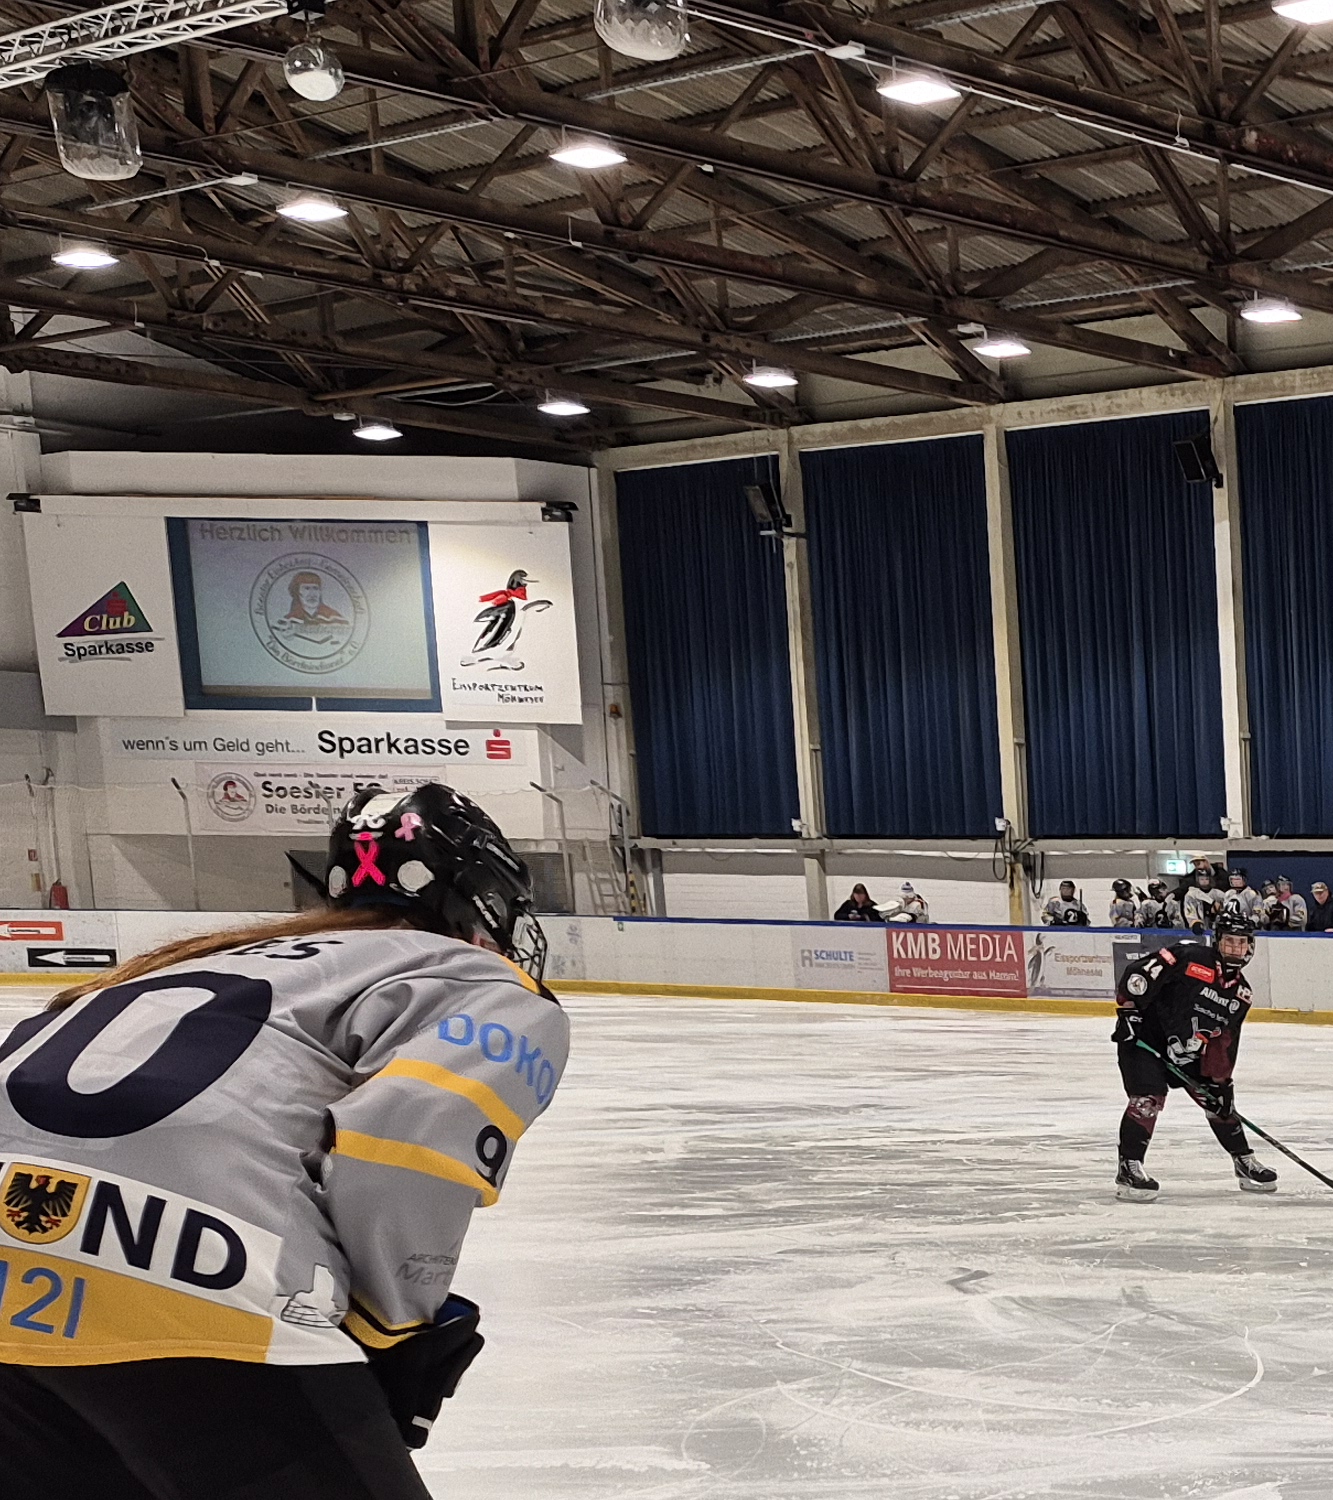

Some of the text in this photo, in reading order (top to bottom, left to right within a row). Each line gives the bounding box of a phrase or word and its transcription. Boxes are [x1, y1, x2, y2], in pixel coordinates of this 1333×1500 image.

[199, 523, 411, 545] Herzlich Willkommen
[83, 611, 136, 632] Club
[63, 641, 155, 660] Sparkasse
[183, 742, 209, 752] um
[212, 737, 250, 752] Geld
[317, 730, 471, 760] Sparkasse
[261, 780, 345, 800] Soester
[264, 804, 287, 815] Die
[813, 949, 855, 962] SCHULTE
[892, 932, 1019, 963] KMB MEDIA
